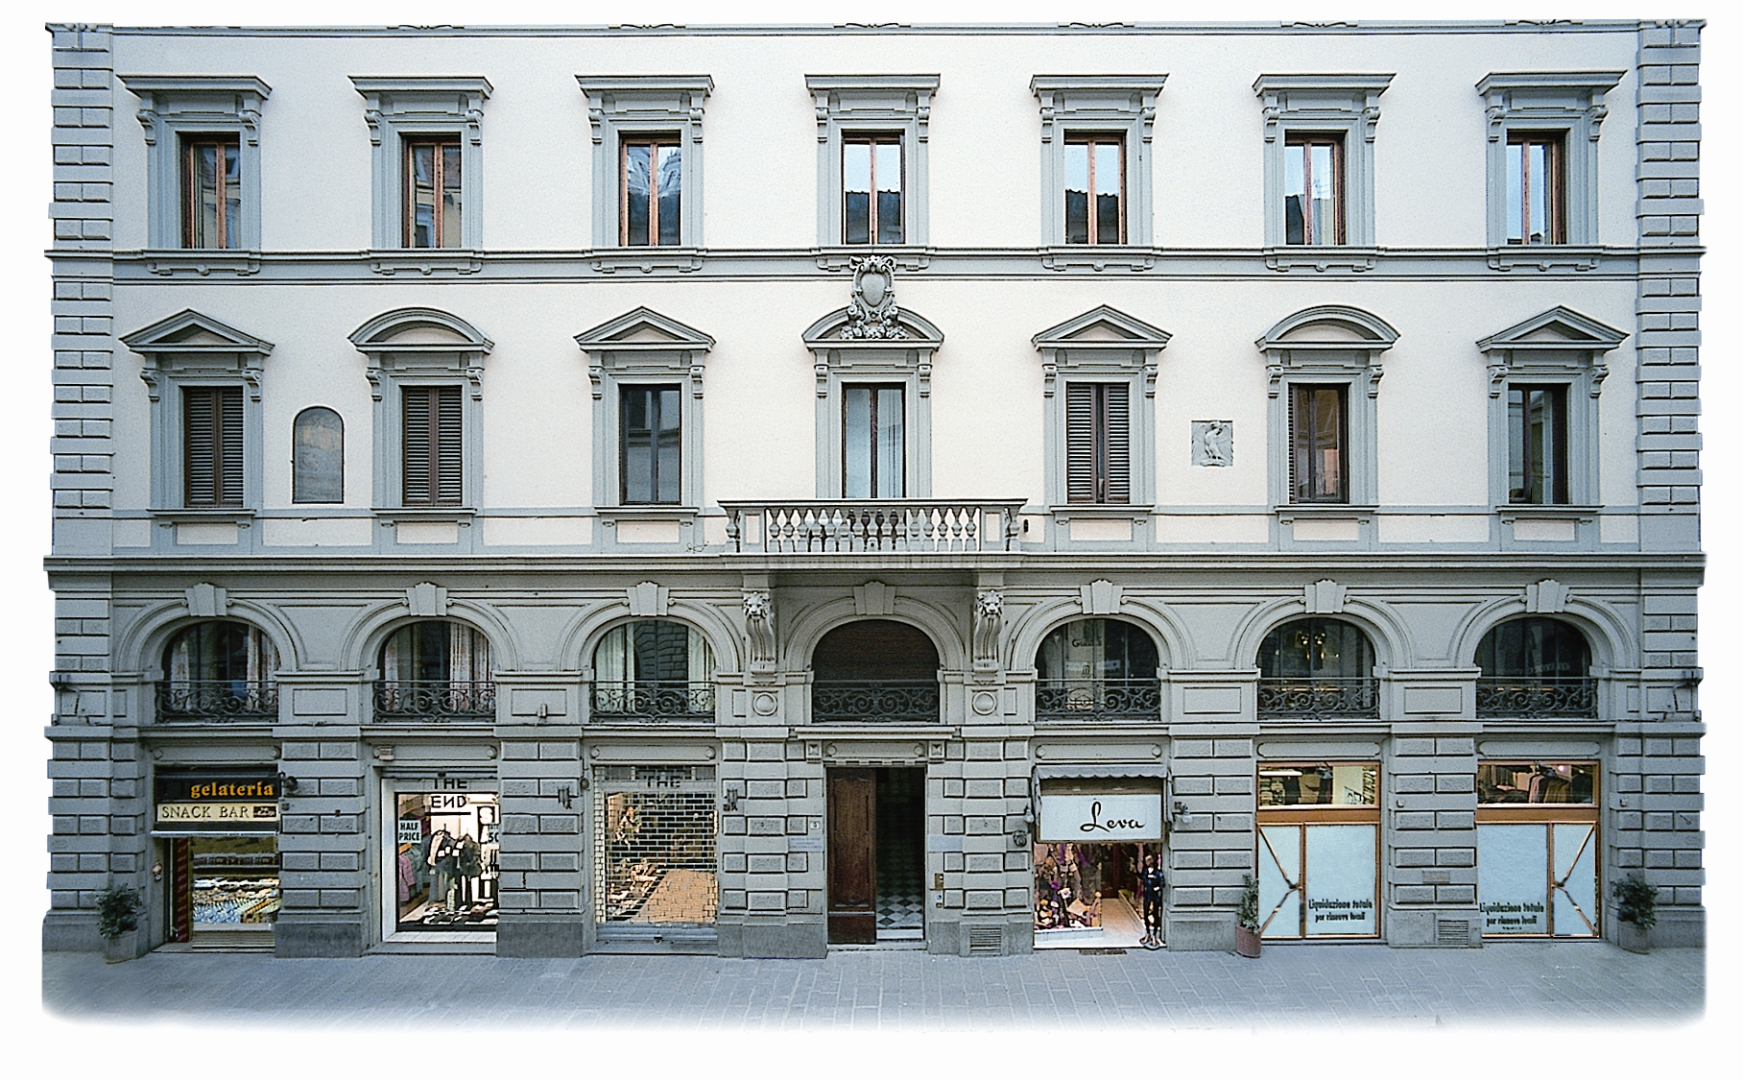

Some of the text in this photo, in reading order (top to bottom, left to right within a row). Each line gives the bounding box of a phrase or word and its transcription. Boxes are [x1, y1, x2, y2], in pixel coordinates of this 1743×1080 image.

[190, 781, 275, 799] gelateria
[161, 806, 211, 818] SNACK
[219, 806, 250, 818] BAR
[1080, 801, 1146, 833] Leva
[400, 822, 419, 831] HALF
[399, 832, 421, 841] PRICE
